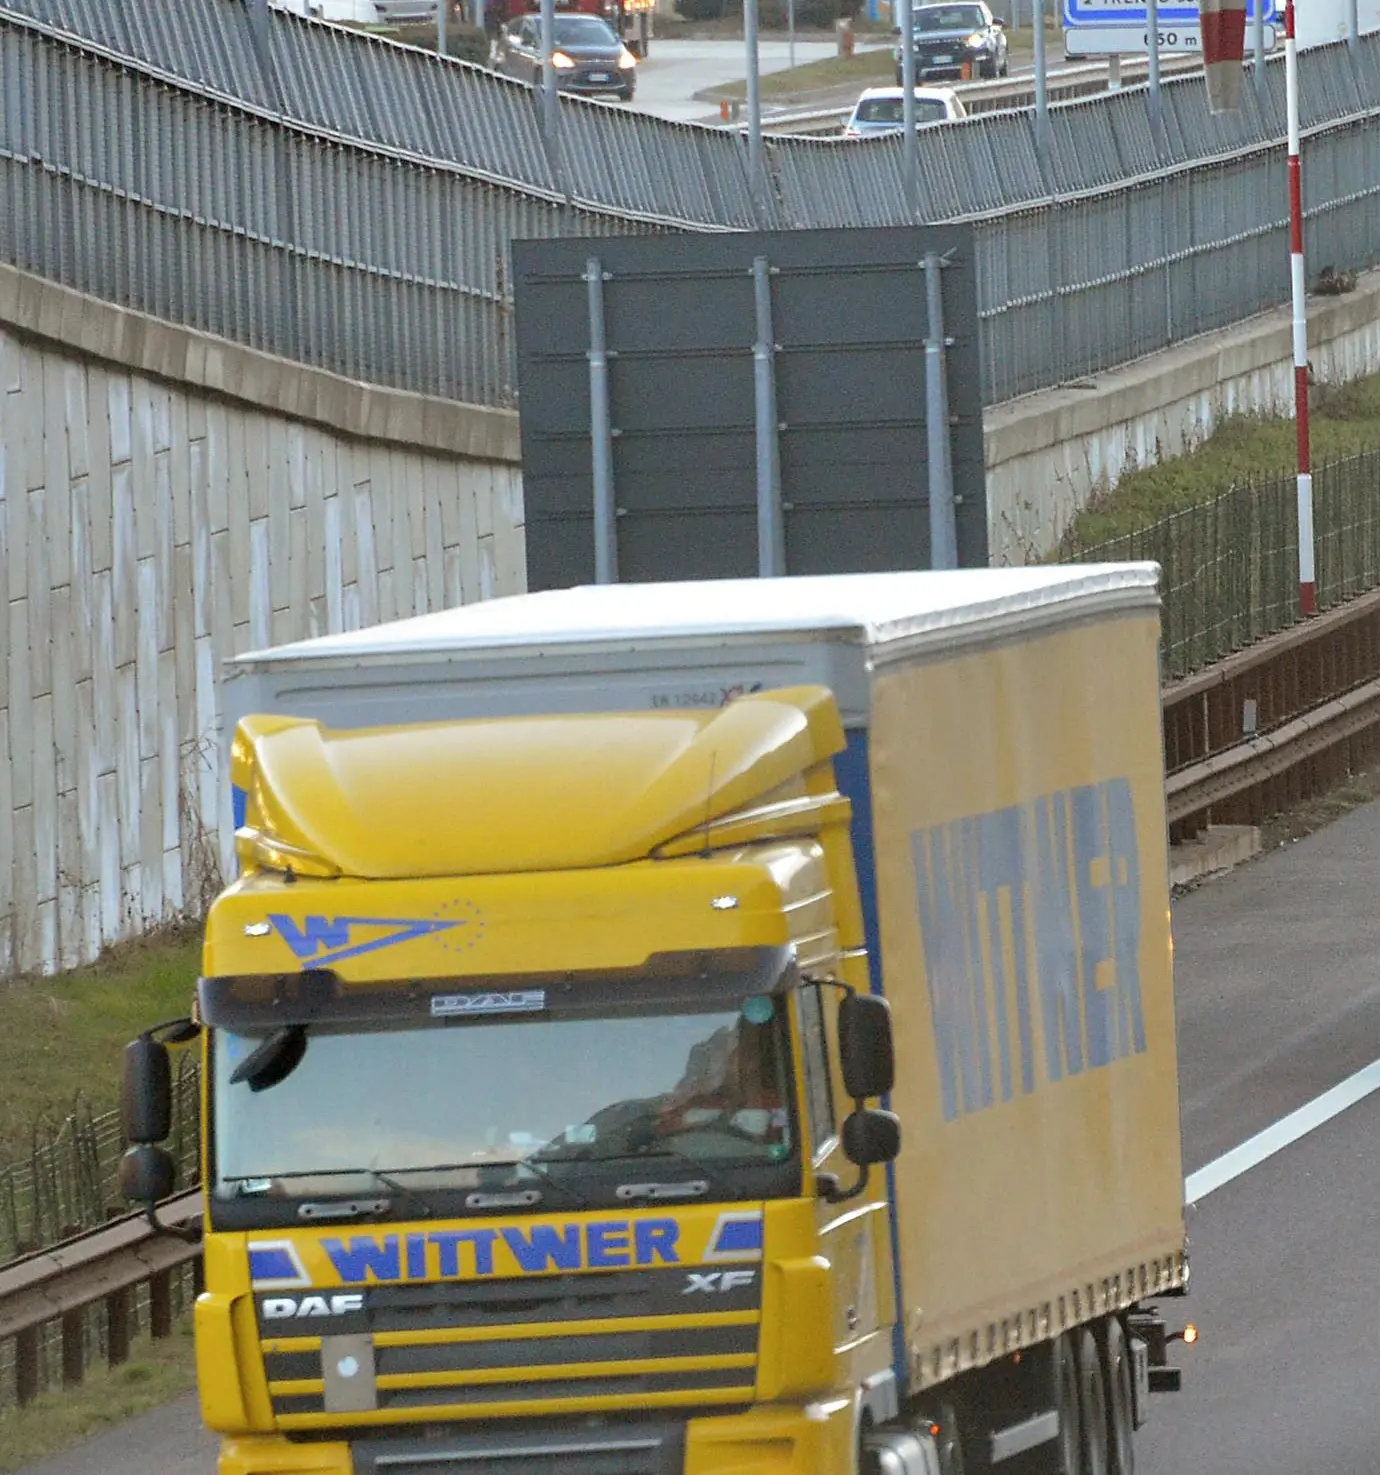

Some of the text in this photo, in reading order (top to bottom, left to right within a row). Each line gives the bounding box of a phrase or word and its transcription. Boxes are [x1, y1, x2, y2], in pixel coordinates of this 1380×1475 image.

[910, 777, 1147, 1123] WITTWER
[320, 1218, 680, 1283] WITTWER
[682, 1270, 756, 1294] XF
[262, 1294, 364, 1320] DAF
